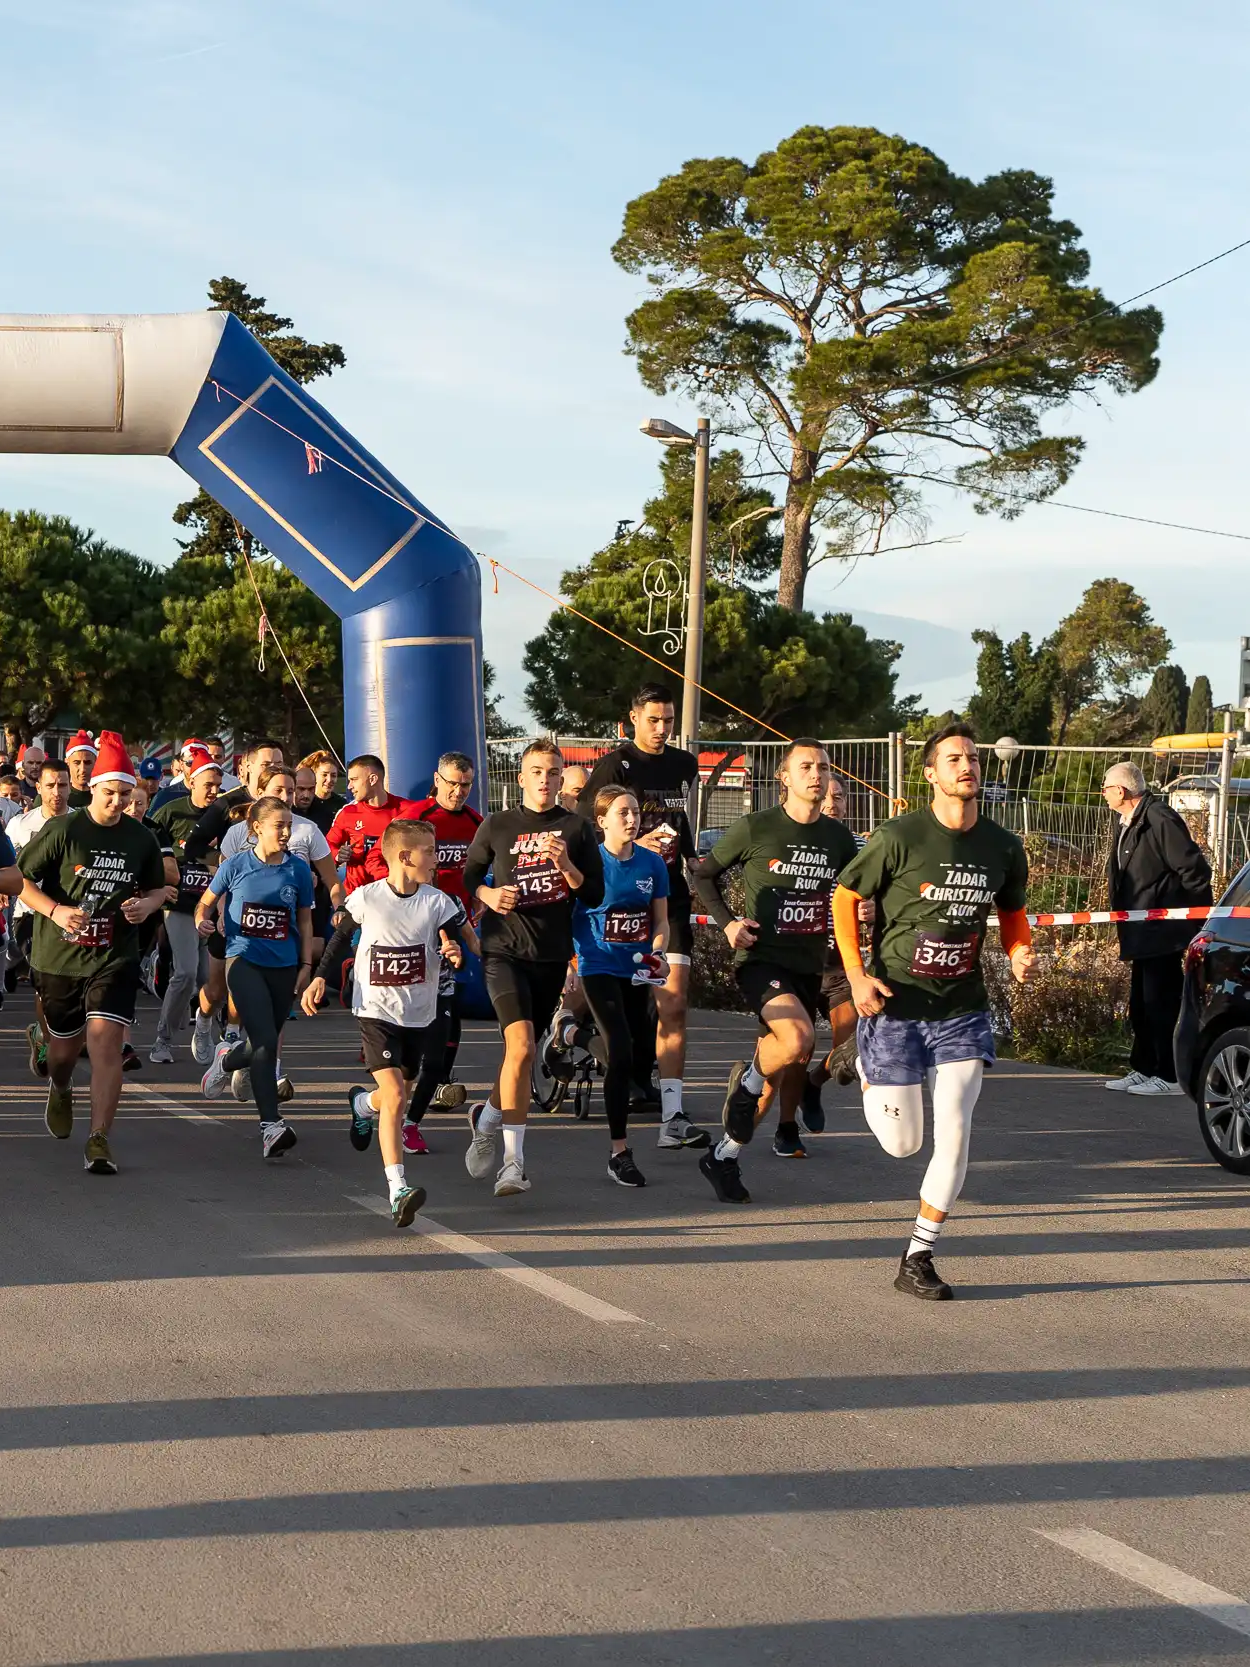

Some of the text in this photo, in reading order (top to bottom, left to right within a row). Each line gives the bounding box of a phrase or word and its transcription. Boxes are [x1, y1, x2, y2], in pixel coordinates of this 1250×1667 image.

[92, 855, 126, 869] ZADAR
[438, 849, 461, 862] 078
[790, 850, 828, 866] ZADAR
[78, 867, 133, 882] CHRISTMAS
[773, 861, 836, 880] CHRISTMAS
[90, 880, 115, 892] RUN
[185, 874, 208, 887] 072
[518, 877, 553, 896] 145
[794, 876, 820, 890] RUN
[944, 870, 988, 888] ZADAR
[924, 884, 996, 904] CHRISTMAS
[782, 906, 815, 923] 004
[946, 902, 978, 916] RUN
[246, 913, 276, 930] 095
[611, 918, 640, 934] 149
[80, 923, 98, 937] 21
[919, 947, 960, 967] 346
[376, 959, 411, 976] 142
